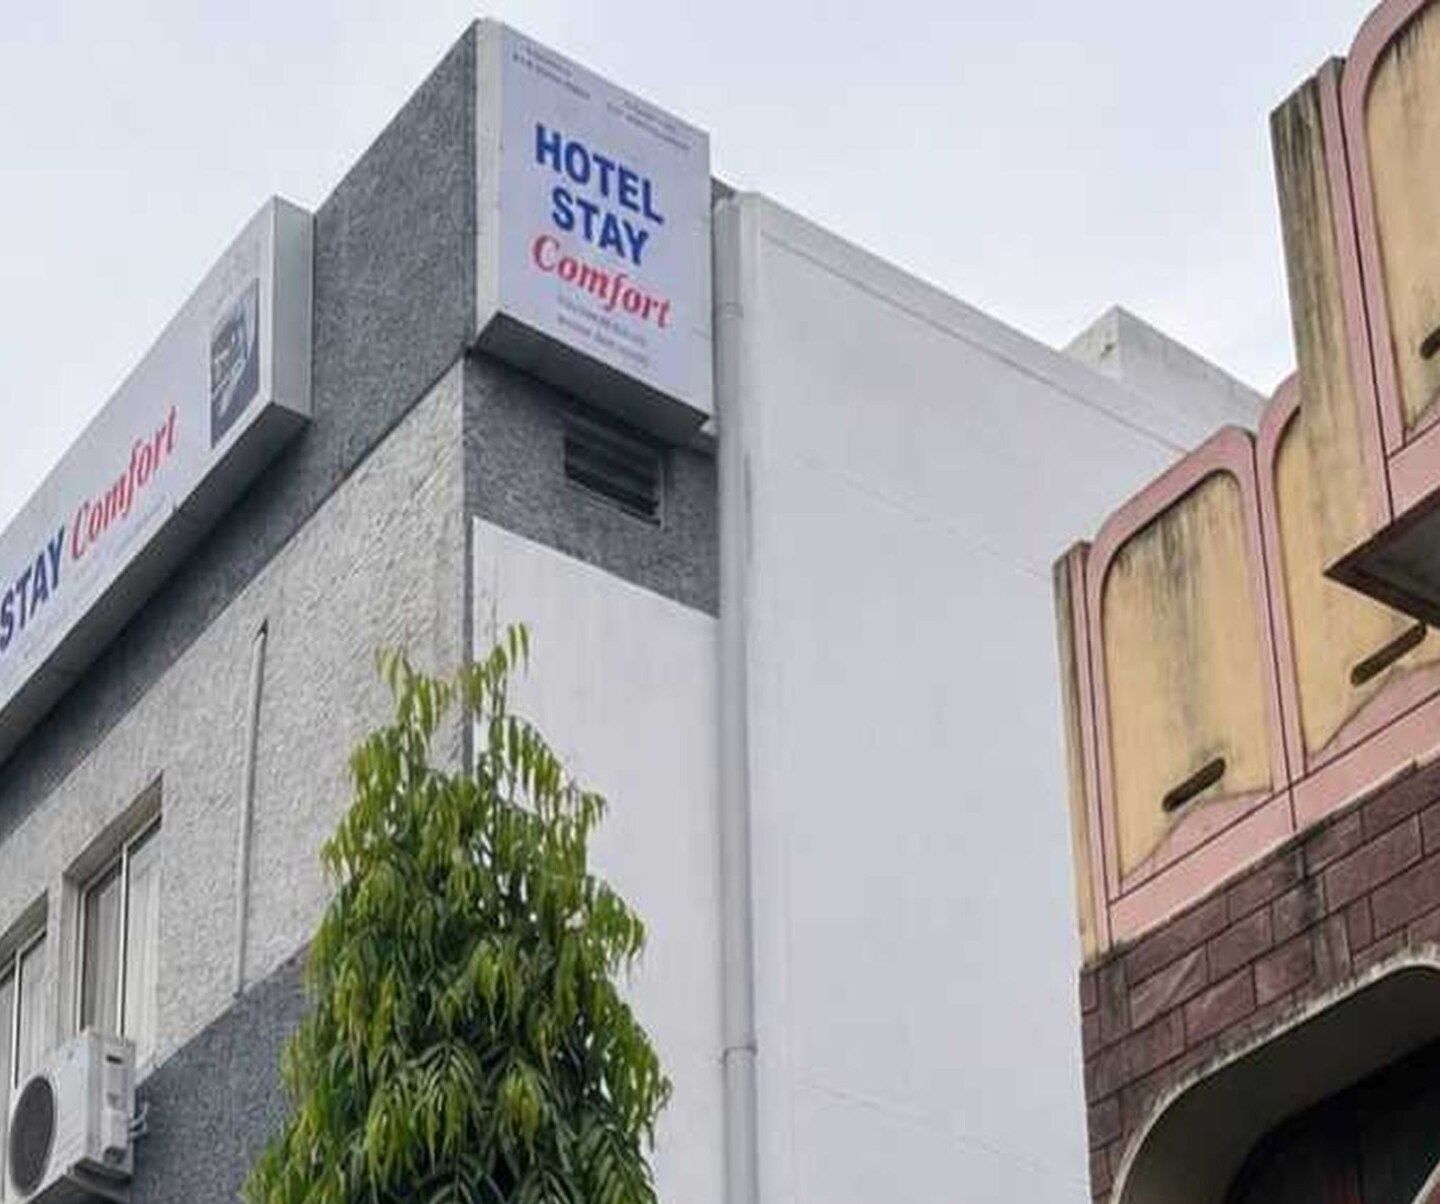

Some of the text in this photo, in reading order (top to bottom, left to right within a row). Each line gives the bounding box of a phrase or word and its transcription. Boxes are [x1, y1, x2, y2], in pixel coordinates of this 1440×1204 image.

[535, 122, 665, 225] HOTEL
[552, 186, 649, 266] STAY
[531, 233, 672, 328] Comfort
[71, 404, 177, 559] Comfort
